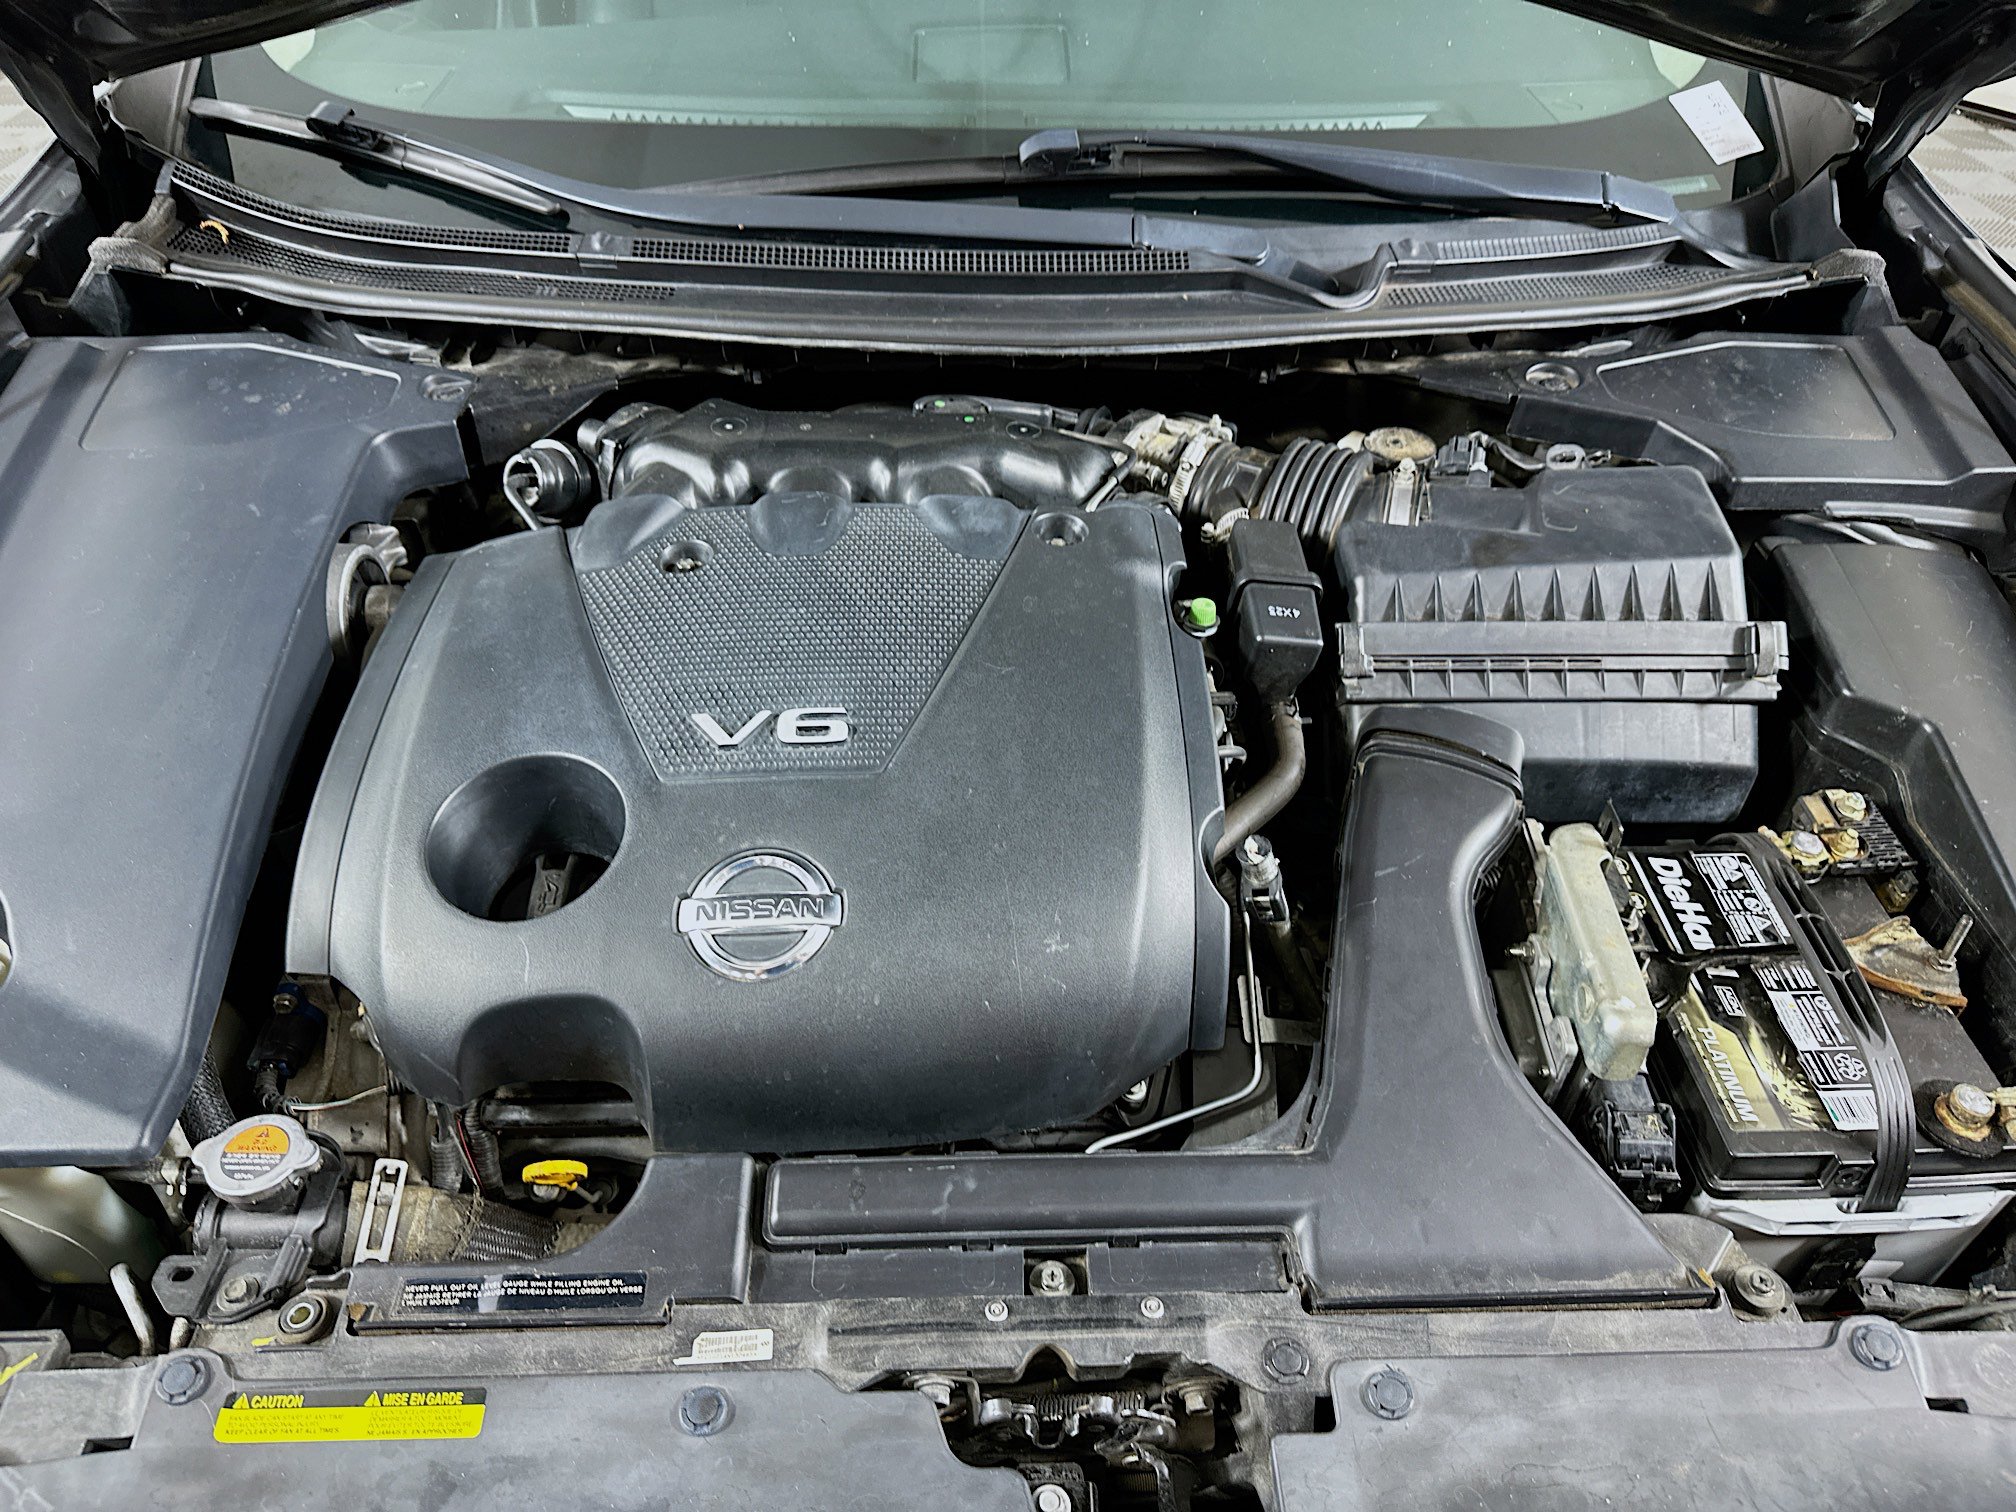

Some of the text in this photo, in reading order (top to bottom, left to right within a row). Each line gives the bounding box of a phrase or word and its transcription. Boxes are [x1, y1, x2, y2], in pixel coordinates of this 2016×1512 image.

[691, 706, 849, 746] V6
[696, 898, 825, 921] NISSAN
[1697, 1027, 1760, 1122] PLATINUM
[430, 1284, 448, 1292] PULL
[450, 1283, 465, 1291] OUT
[502, 1280, 528, 1289] GAUGE
[530, 1280, 553, 1288] WHILE
[554, 1280, 582, 1288] FILLING
[582, 1279, 610, 1287] ENGINE
[507, 1287, 517, 1295] DE
[519, 1287, 546, 1296] NIVEAU
[620, 1285, 643, 1294] VERSE
[251, 1395, 304, 1408] CAUTION
[382, 1392, 464, 1406] MISE EN GARDE
